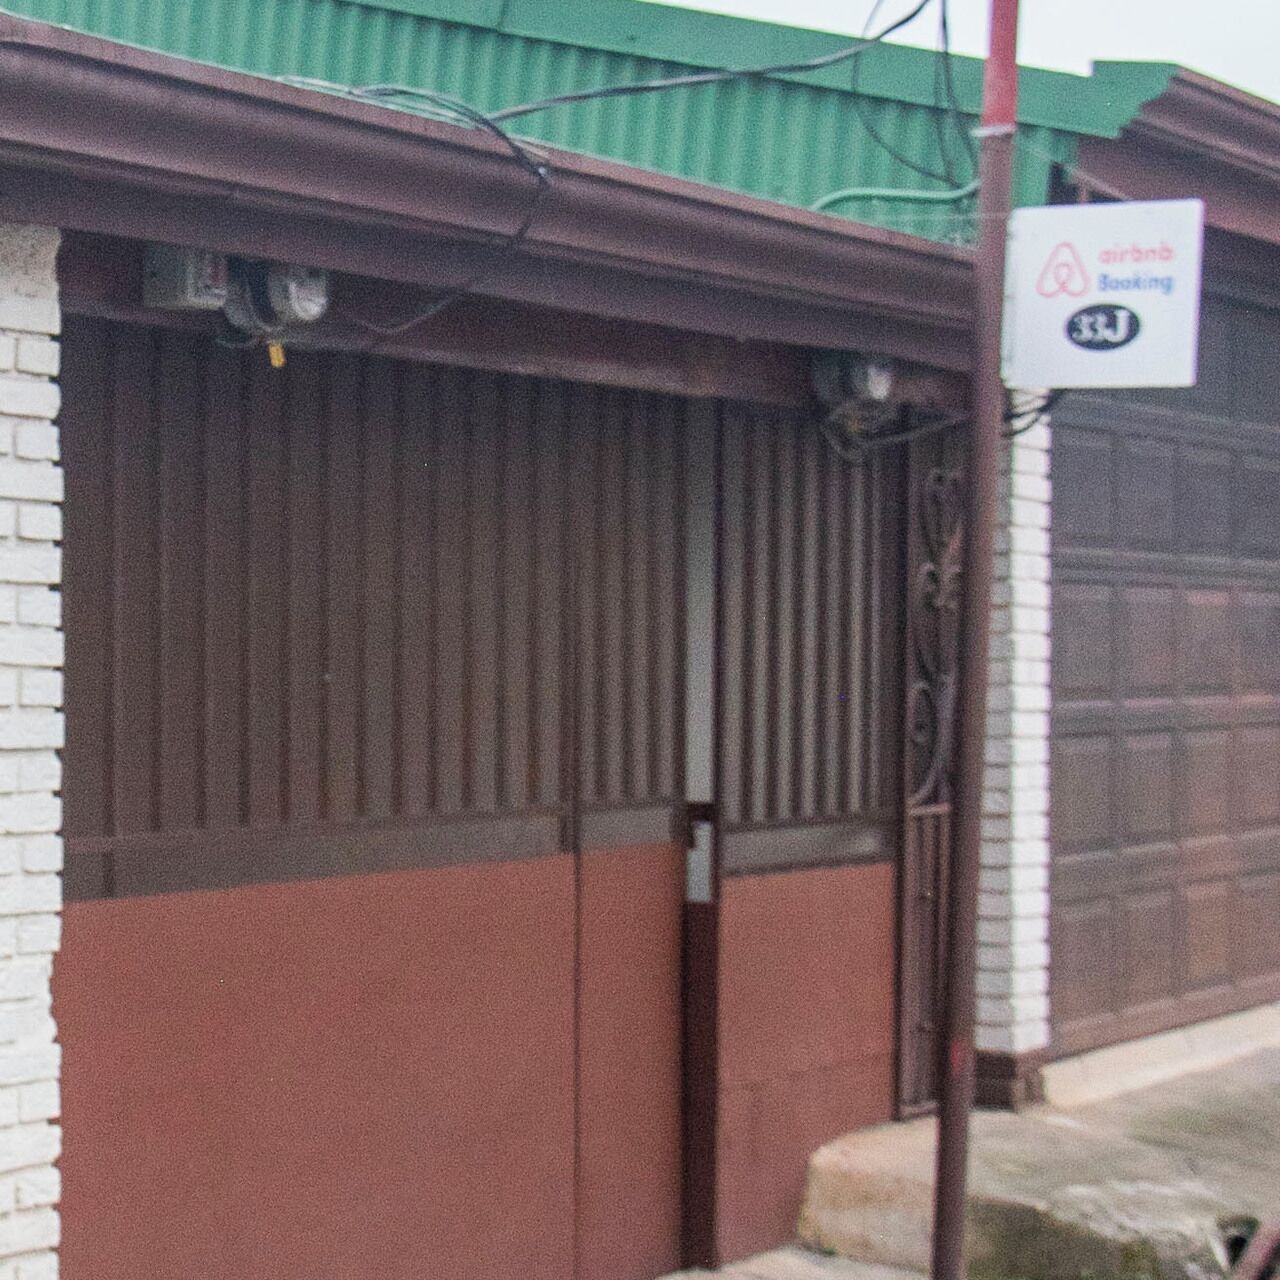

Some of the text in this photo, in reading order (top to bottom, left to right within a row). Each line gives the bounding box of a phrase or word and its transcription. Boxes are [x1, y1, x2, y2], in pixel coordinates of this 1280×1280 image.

[1099, 243, 1174, 264] airbnb
[1099, 273, 1174, 295] Booking
[1071, 309, 1130, 343] 33J
